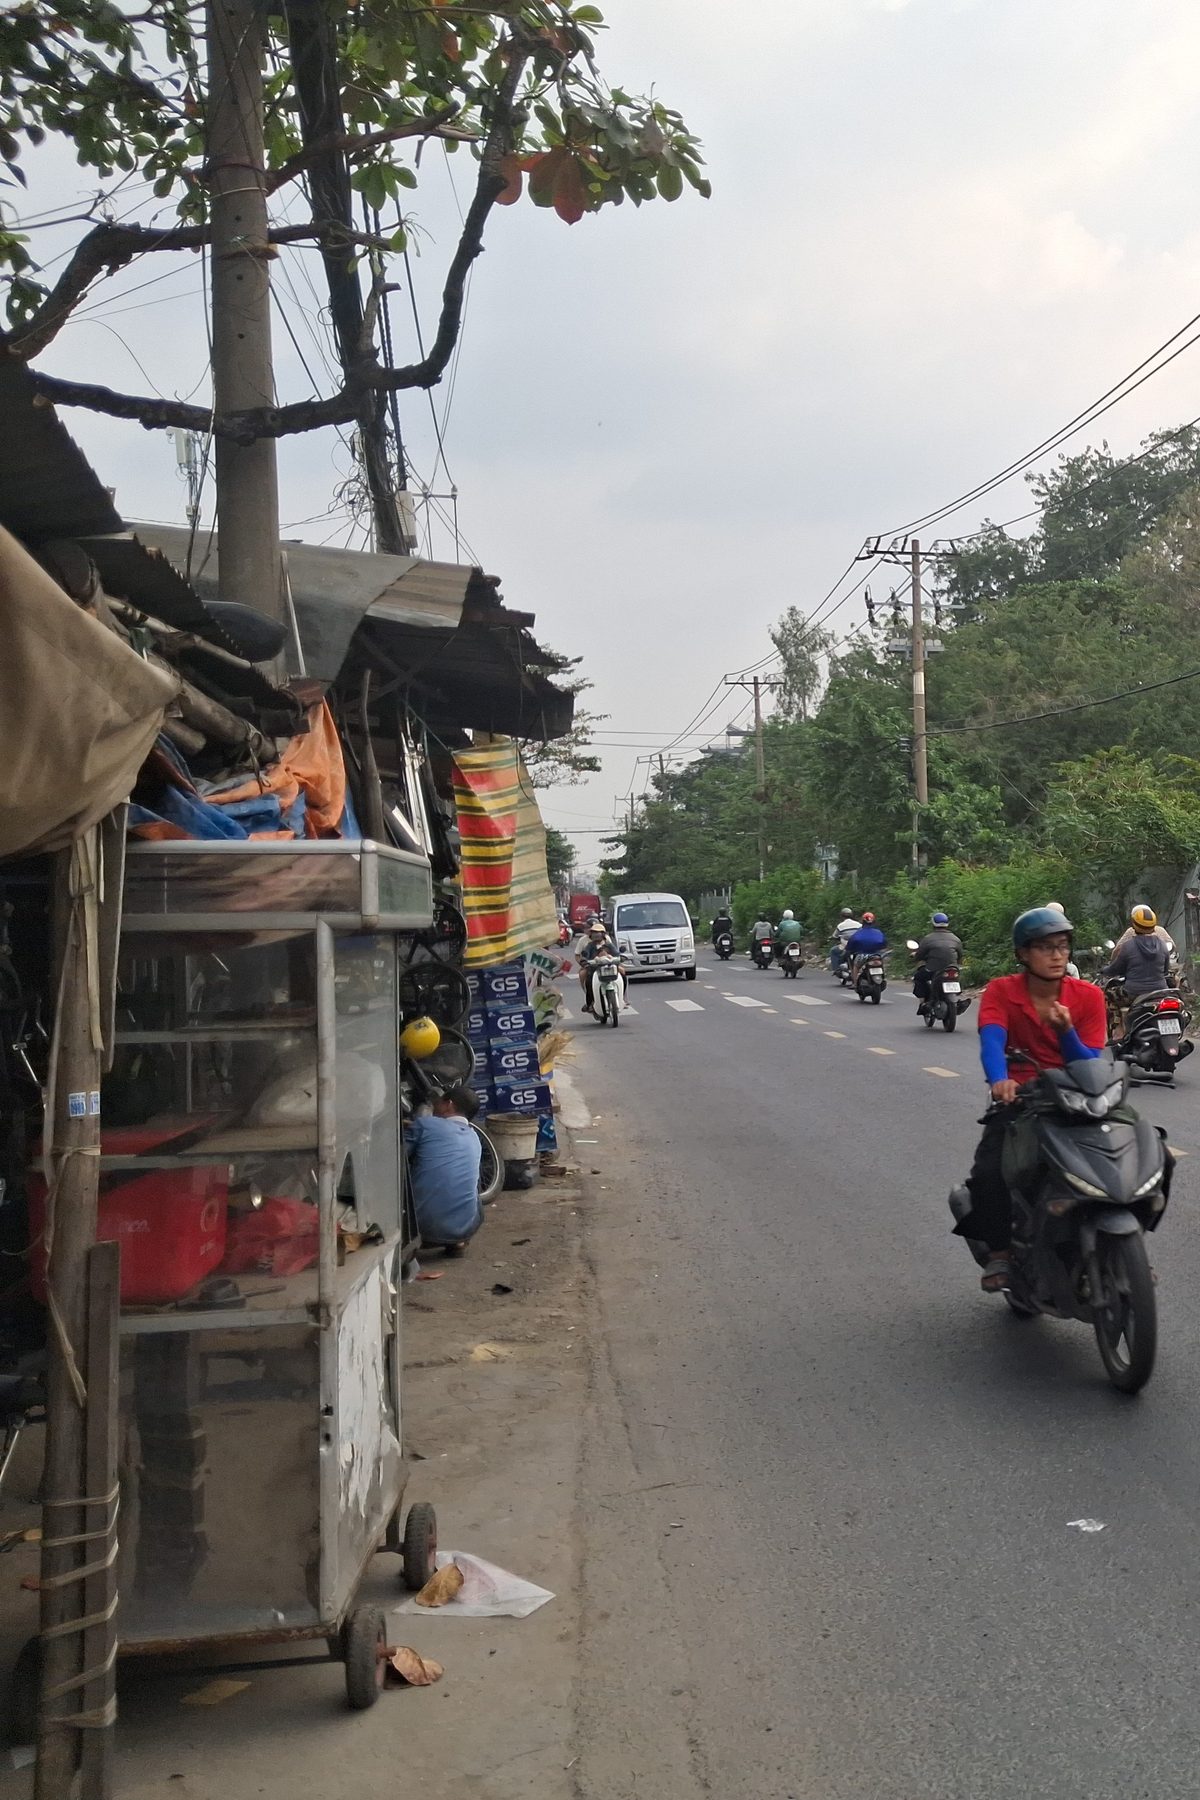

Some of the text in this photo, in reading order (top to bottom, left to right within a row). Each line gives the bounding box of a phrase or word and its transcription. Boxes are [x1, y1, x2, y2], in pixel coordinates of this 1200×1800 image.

[491, 976, 520, 992] GS
[497, 1014, 525, 1030] GS
[501, 1052, 530, 1068] GS
[510, 1090, 537, 1105] GS
